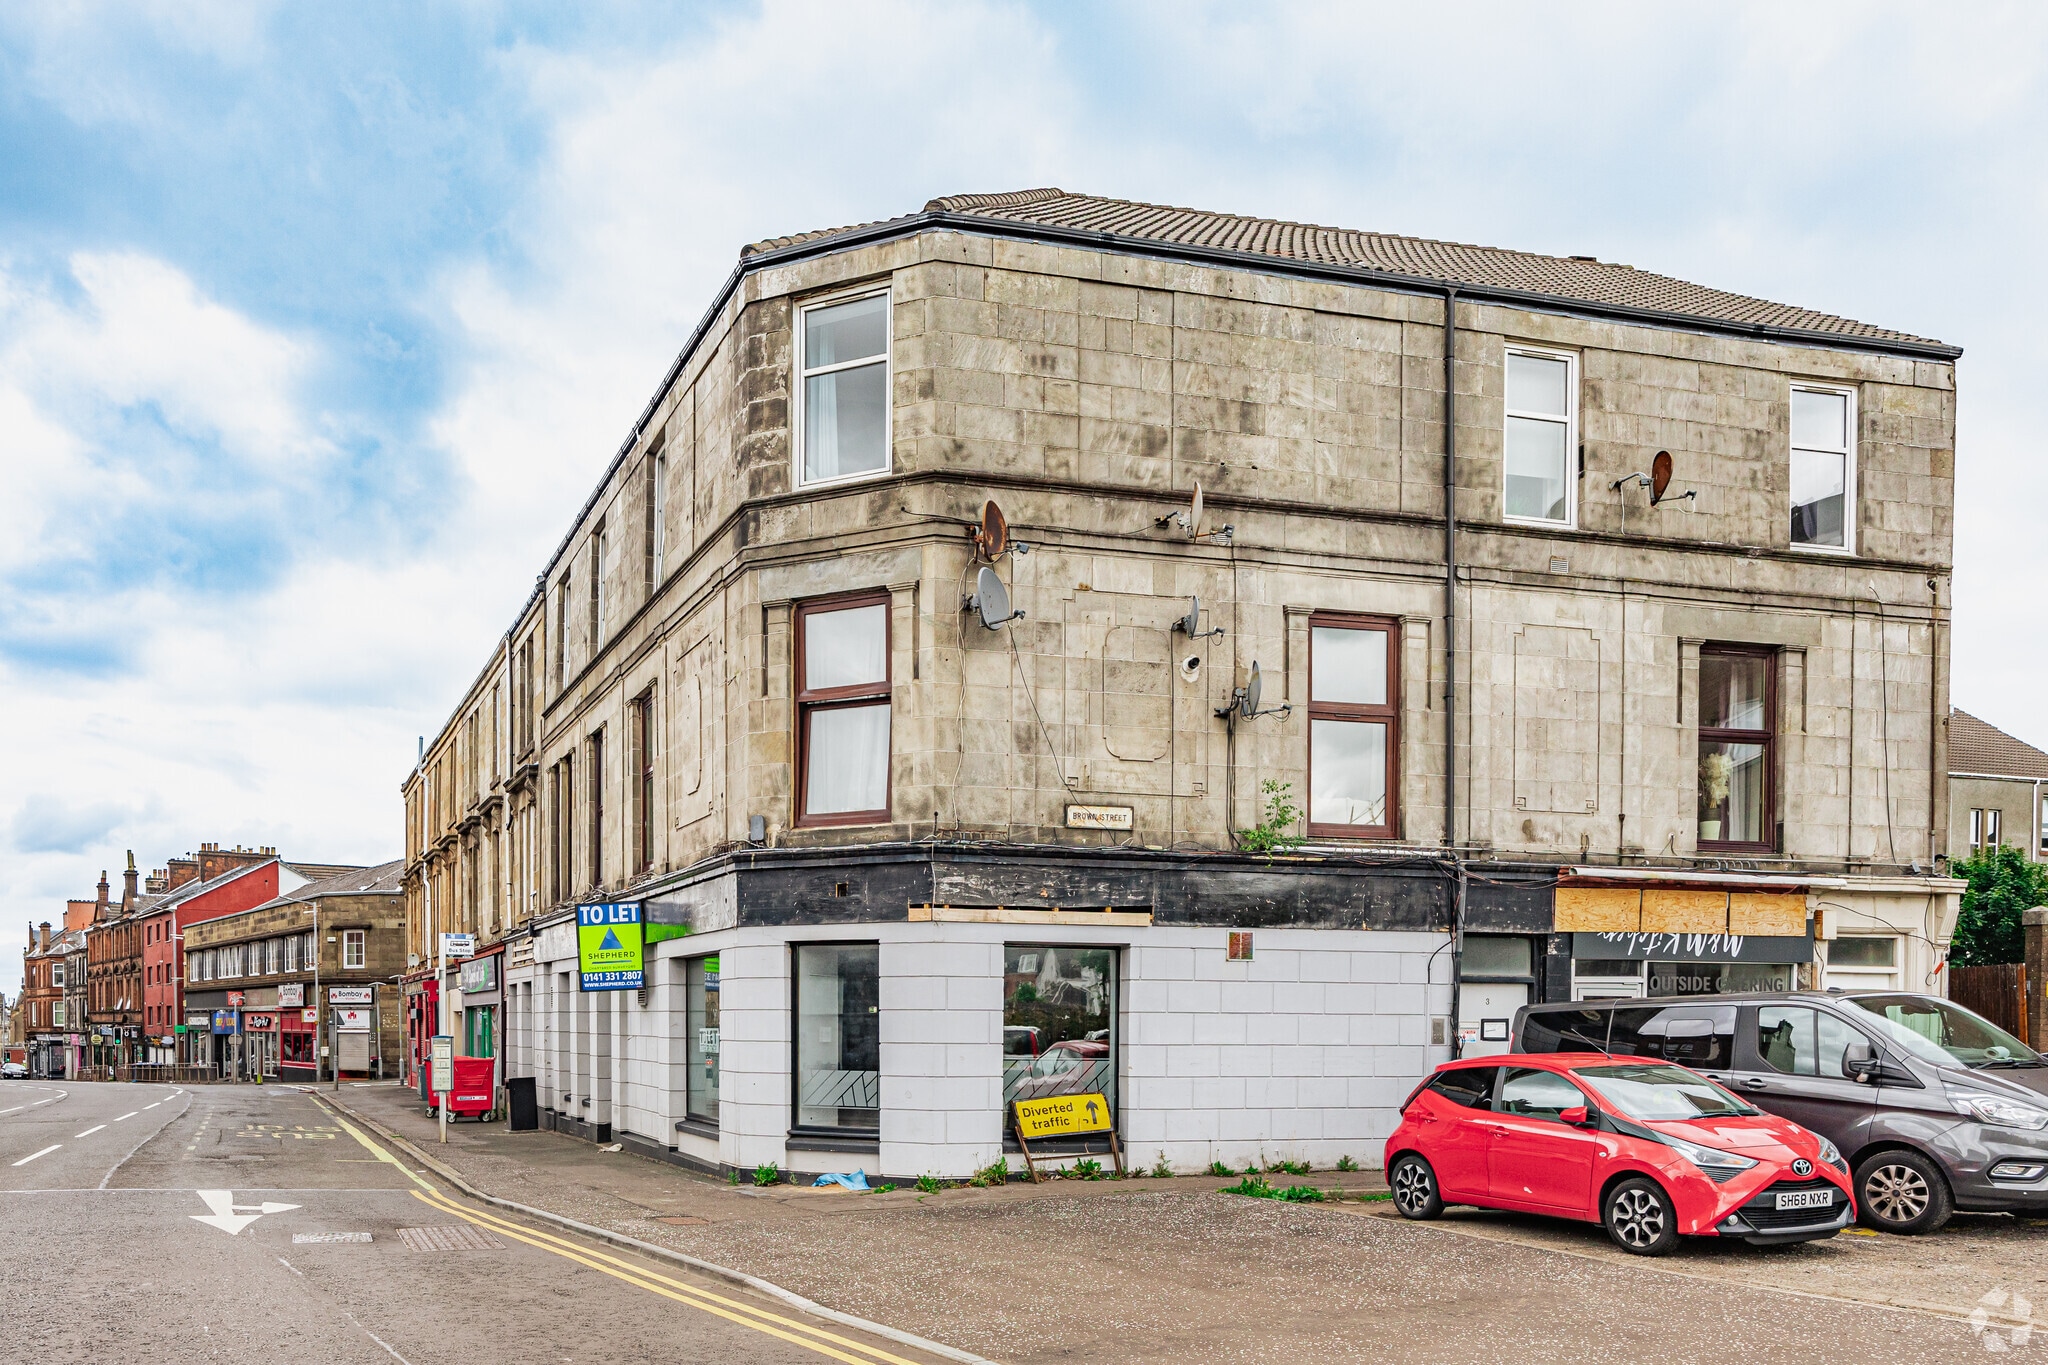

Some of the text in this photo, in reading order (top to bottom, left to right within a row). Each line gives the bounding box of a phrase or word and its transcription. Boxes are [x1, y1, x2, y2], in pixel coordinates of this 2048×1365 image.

[1072, 812, 1127, 822] BROWN STREET
[580, 903, 639, 924] TO LET
[1686, 931, 1744, 958] M&M
[588, 951, 636, 960] SHEPHERD
[583, 971, 642, 982] 0141 331 2807
[1649, 976, 1784, 992] OUTSIDE CERING
[338, 990, 363, 998] Bombay
[1022, 1102, 1073, 1118] Diverted
[1032, 1116, 1070, 1130] traffic
[236, 1132, 336, 1140] BUS
[1781, 1192, 1829, 1207] SH68 NXR
